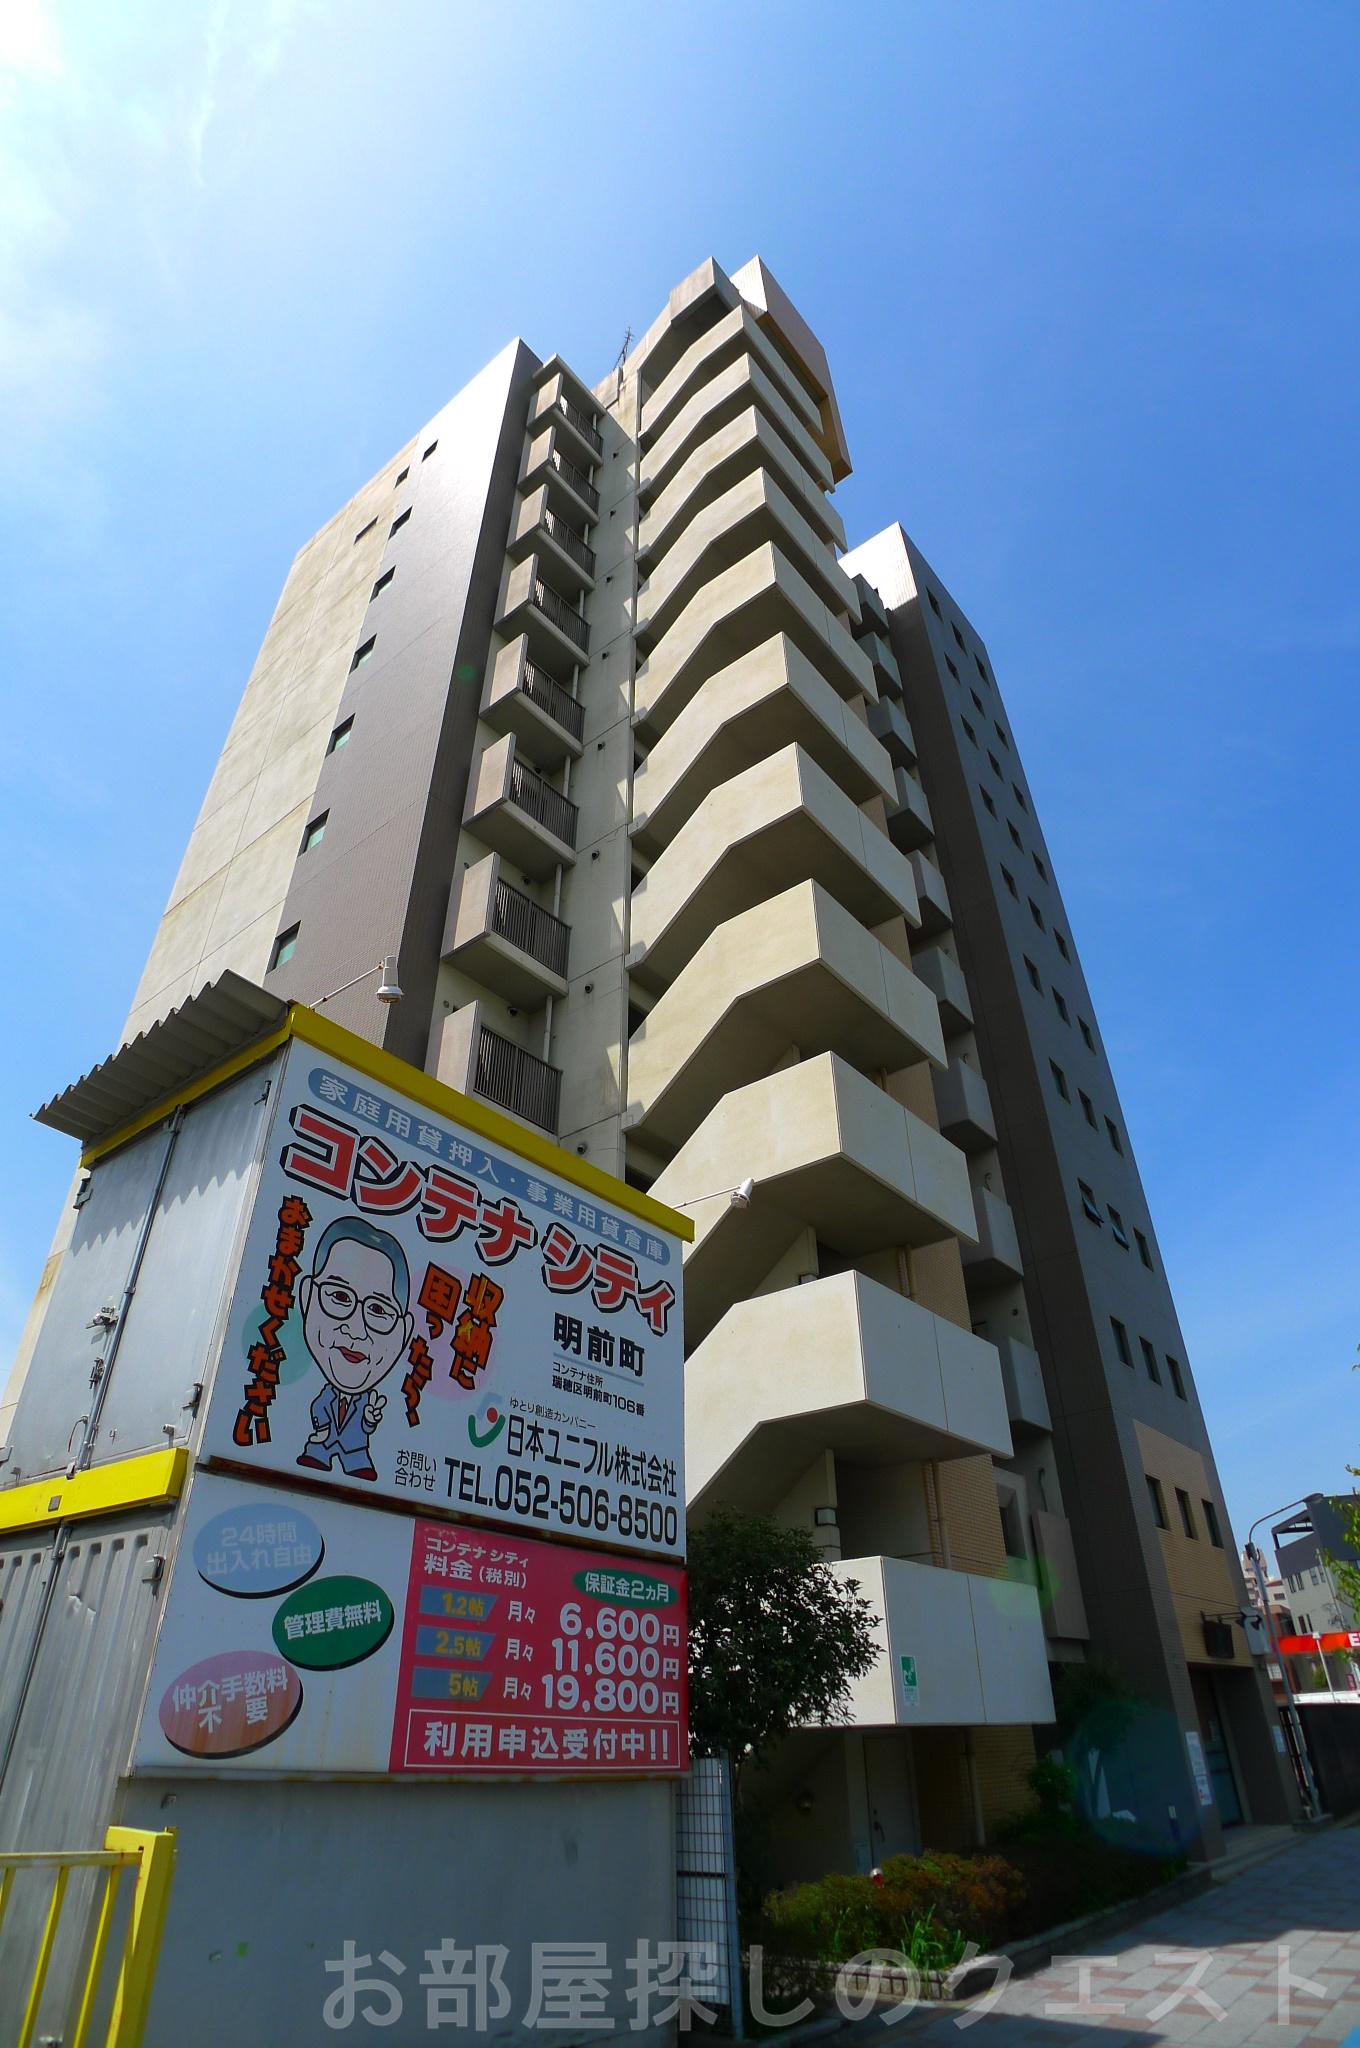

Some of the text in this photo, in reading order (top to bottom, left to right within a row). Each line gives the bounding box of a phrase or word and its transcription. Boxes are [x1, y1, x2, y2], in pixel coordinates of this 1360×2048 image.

[319, 1075, 664, 1261] 家庭用貸押入・事業用貸倉庫
[233, 1194, 313, 1446] おまかせください
[449, 1272, 504, 1390] 収納に
[553, 1312, 645, 1377] 明前町
[552, 1361, 604, 1388] コンテナ住所
[552, 1375, 645, 1417] 瑞穂区明前町106番
[396, 1449, 438, 1473] お問い
[507, 1414, 677, 1497] 日本ユニフル株式会社
[394, 1467, 436, 1492] 合わせ
[444, 1456, 678, 1546] TEL.052-506-8500
[221, 1521, 298, 1547] 24時間
[207, 1544, 313, 1575] 出入れ自由
[284, 1600, 382, 1640] 管理費無料
[442, 1592, 680, 1648] 1.2帖 月々 6,600円
[435, 1631, 680, 1680] 2.5帖 月々 11,600円
[172, 1666, 289, 1712] 仲介手数料
[449, 1673, 680, 1715] 5帖 月々 19,800円
